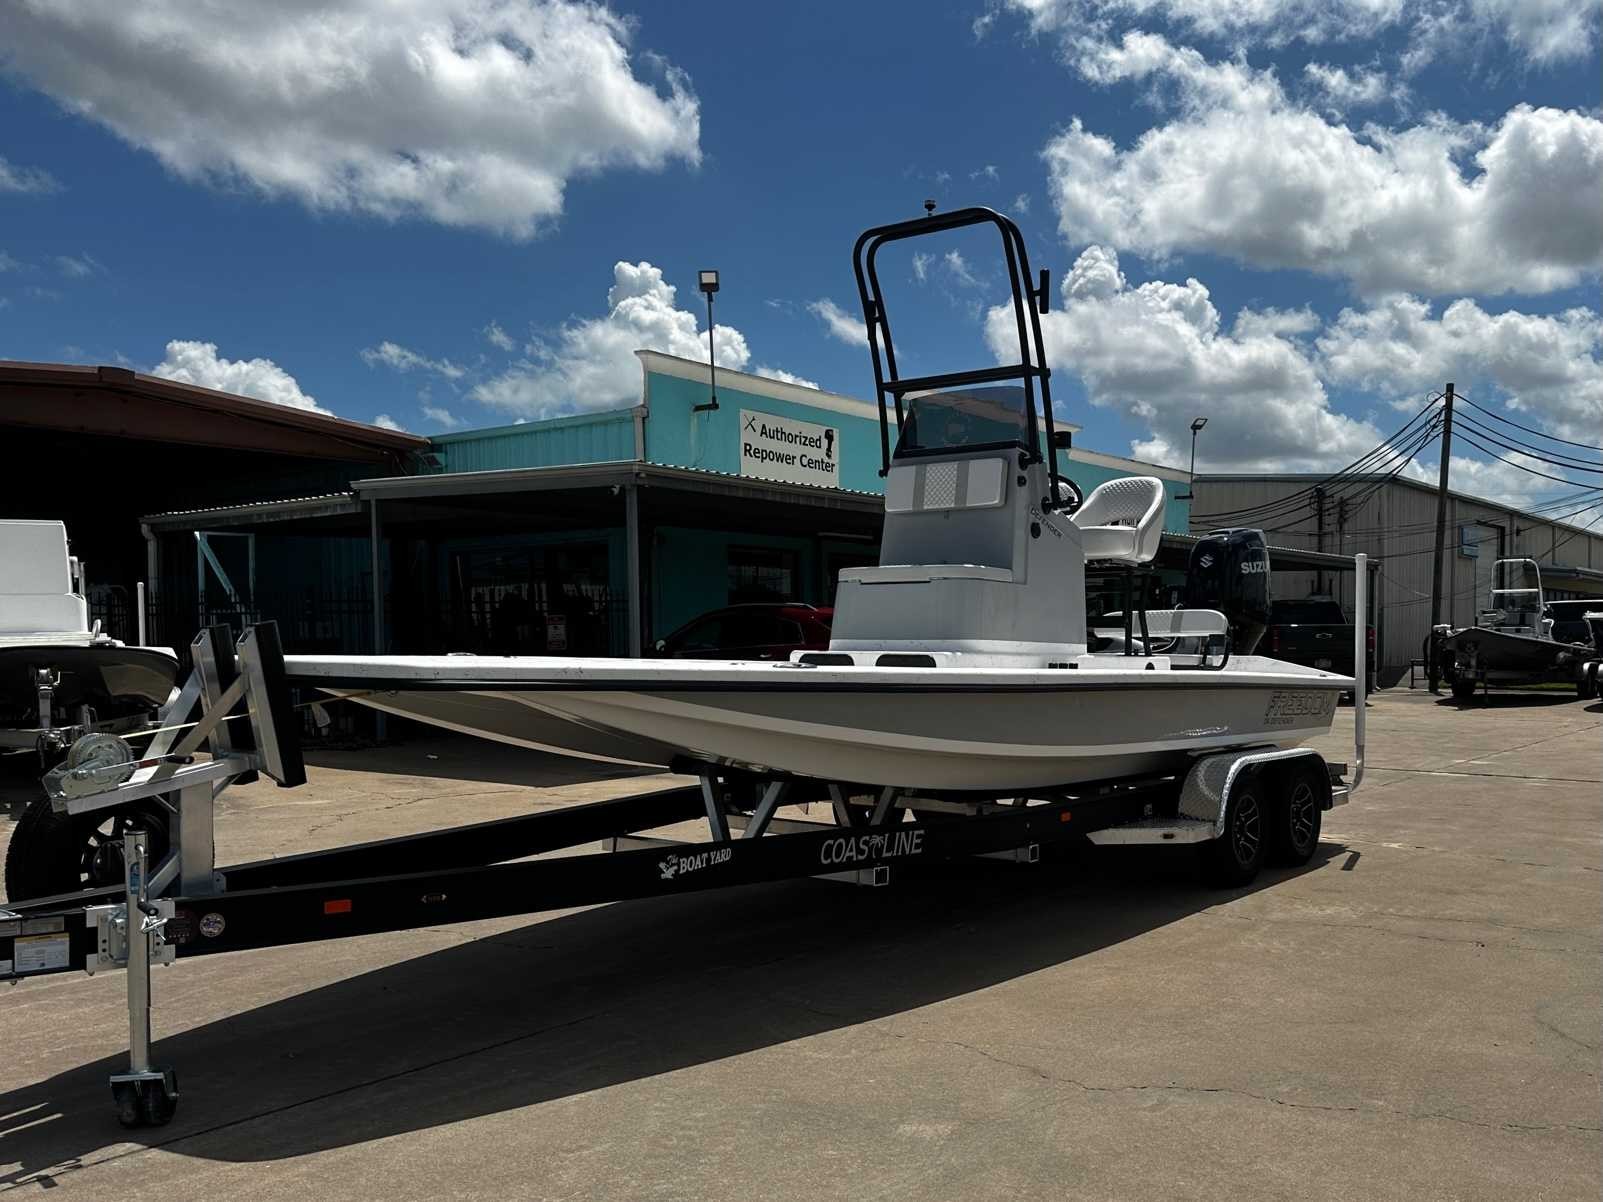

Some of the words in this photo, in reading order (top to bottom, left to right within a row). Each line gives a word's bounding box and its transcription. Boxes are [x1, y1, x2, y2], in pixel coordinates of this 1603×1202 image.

[760, 424, 821, 448] Authorized
[744, 442, 796, 465] Repower
[800, 454, 835, 473] Center
[679, 852, 709, 874] BOAT
[709, 848, 732, 865] YARD
